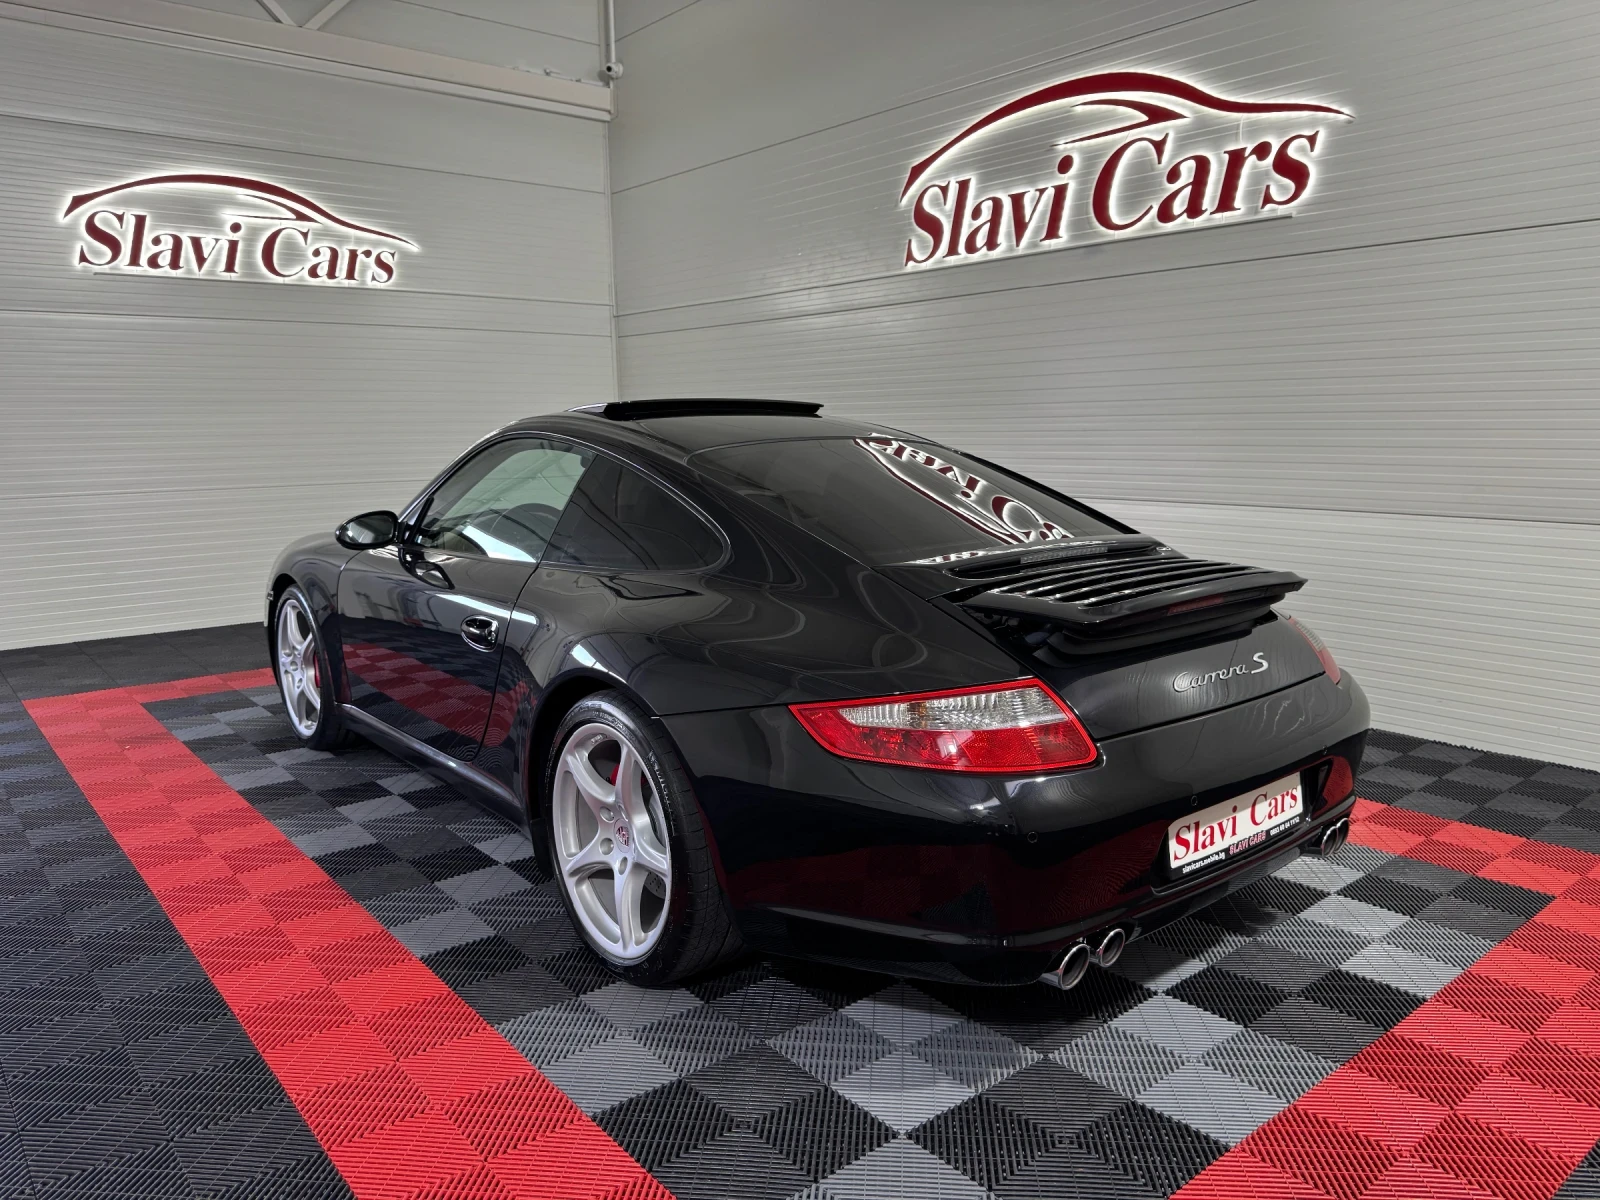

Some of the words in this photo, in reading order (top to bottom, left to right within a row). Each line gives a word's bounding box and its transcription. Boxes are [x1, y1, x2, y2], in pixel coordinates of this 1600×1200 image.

[904, 154, 1074, 267] Slavi
[1092, 130, 1321, 231] Cars
[78, 210, 243, 274] Slavi
[260, 226, 396, 284] Cars
[1173, 664, 1249, 693] Carrera
[1251, 652, 1269, 674] S
[1173, 805, 1237, 862] Slavi
[1250, 787, 1298, 826] Cars
[1229, 838, 1249, 855] SLAVI
[1249, 830, 1266, 846] CARS
